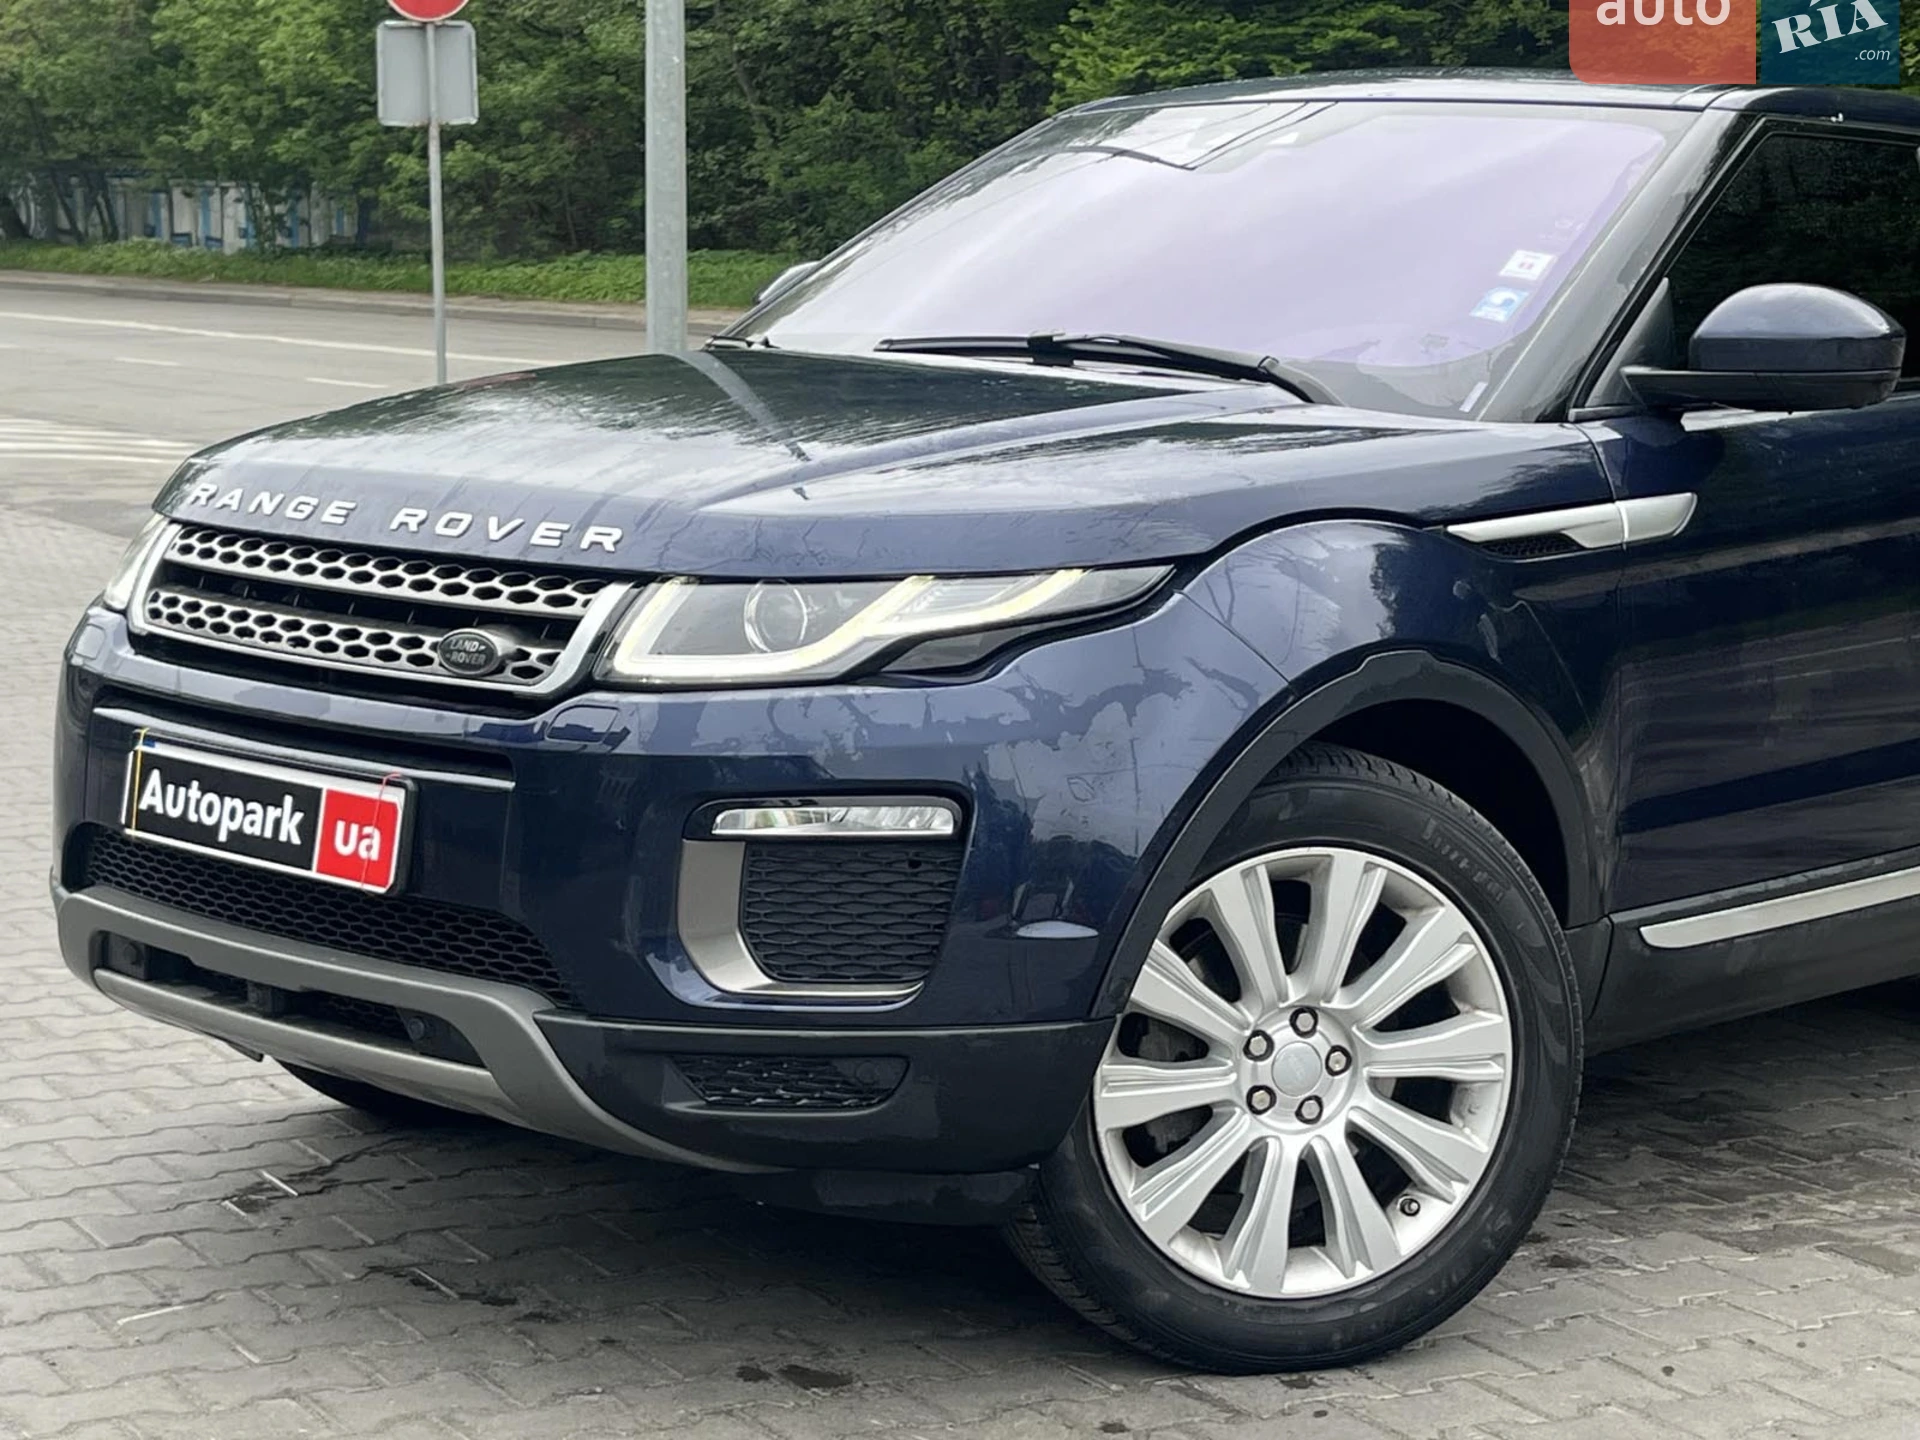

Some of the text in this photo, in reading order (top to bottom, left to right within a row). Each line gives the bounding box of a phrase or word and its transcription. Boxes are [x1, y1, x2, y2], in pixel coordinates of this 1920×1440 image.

[189, 482, 624, 553] RANGE ROVER
[450, 639, 480, 652] LAND
[450, 651, 486, 665] ROVER
[138, 768, 382, 862] Autopark ua
